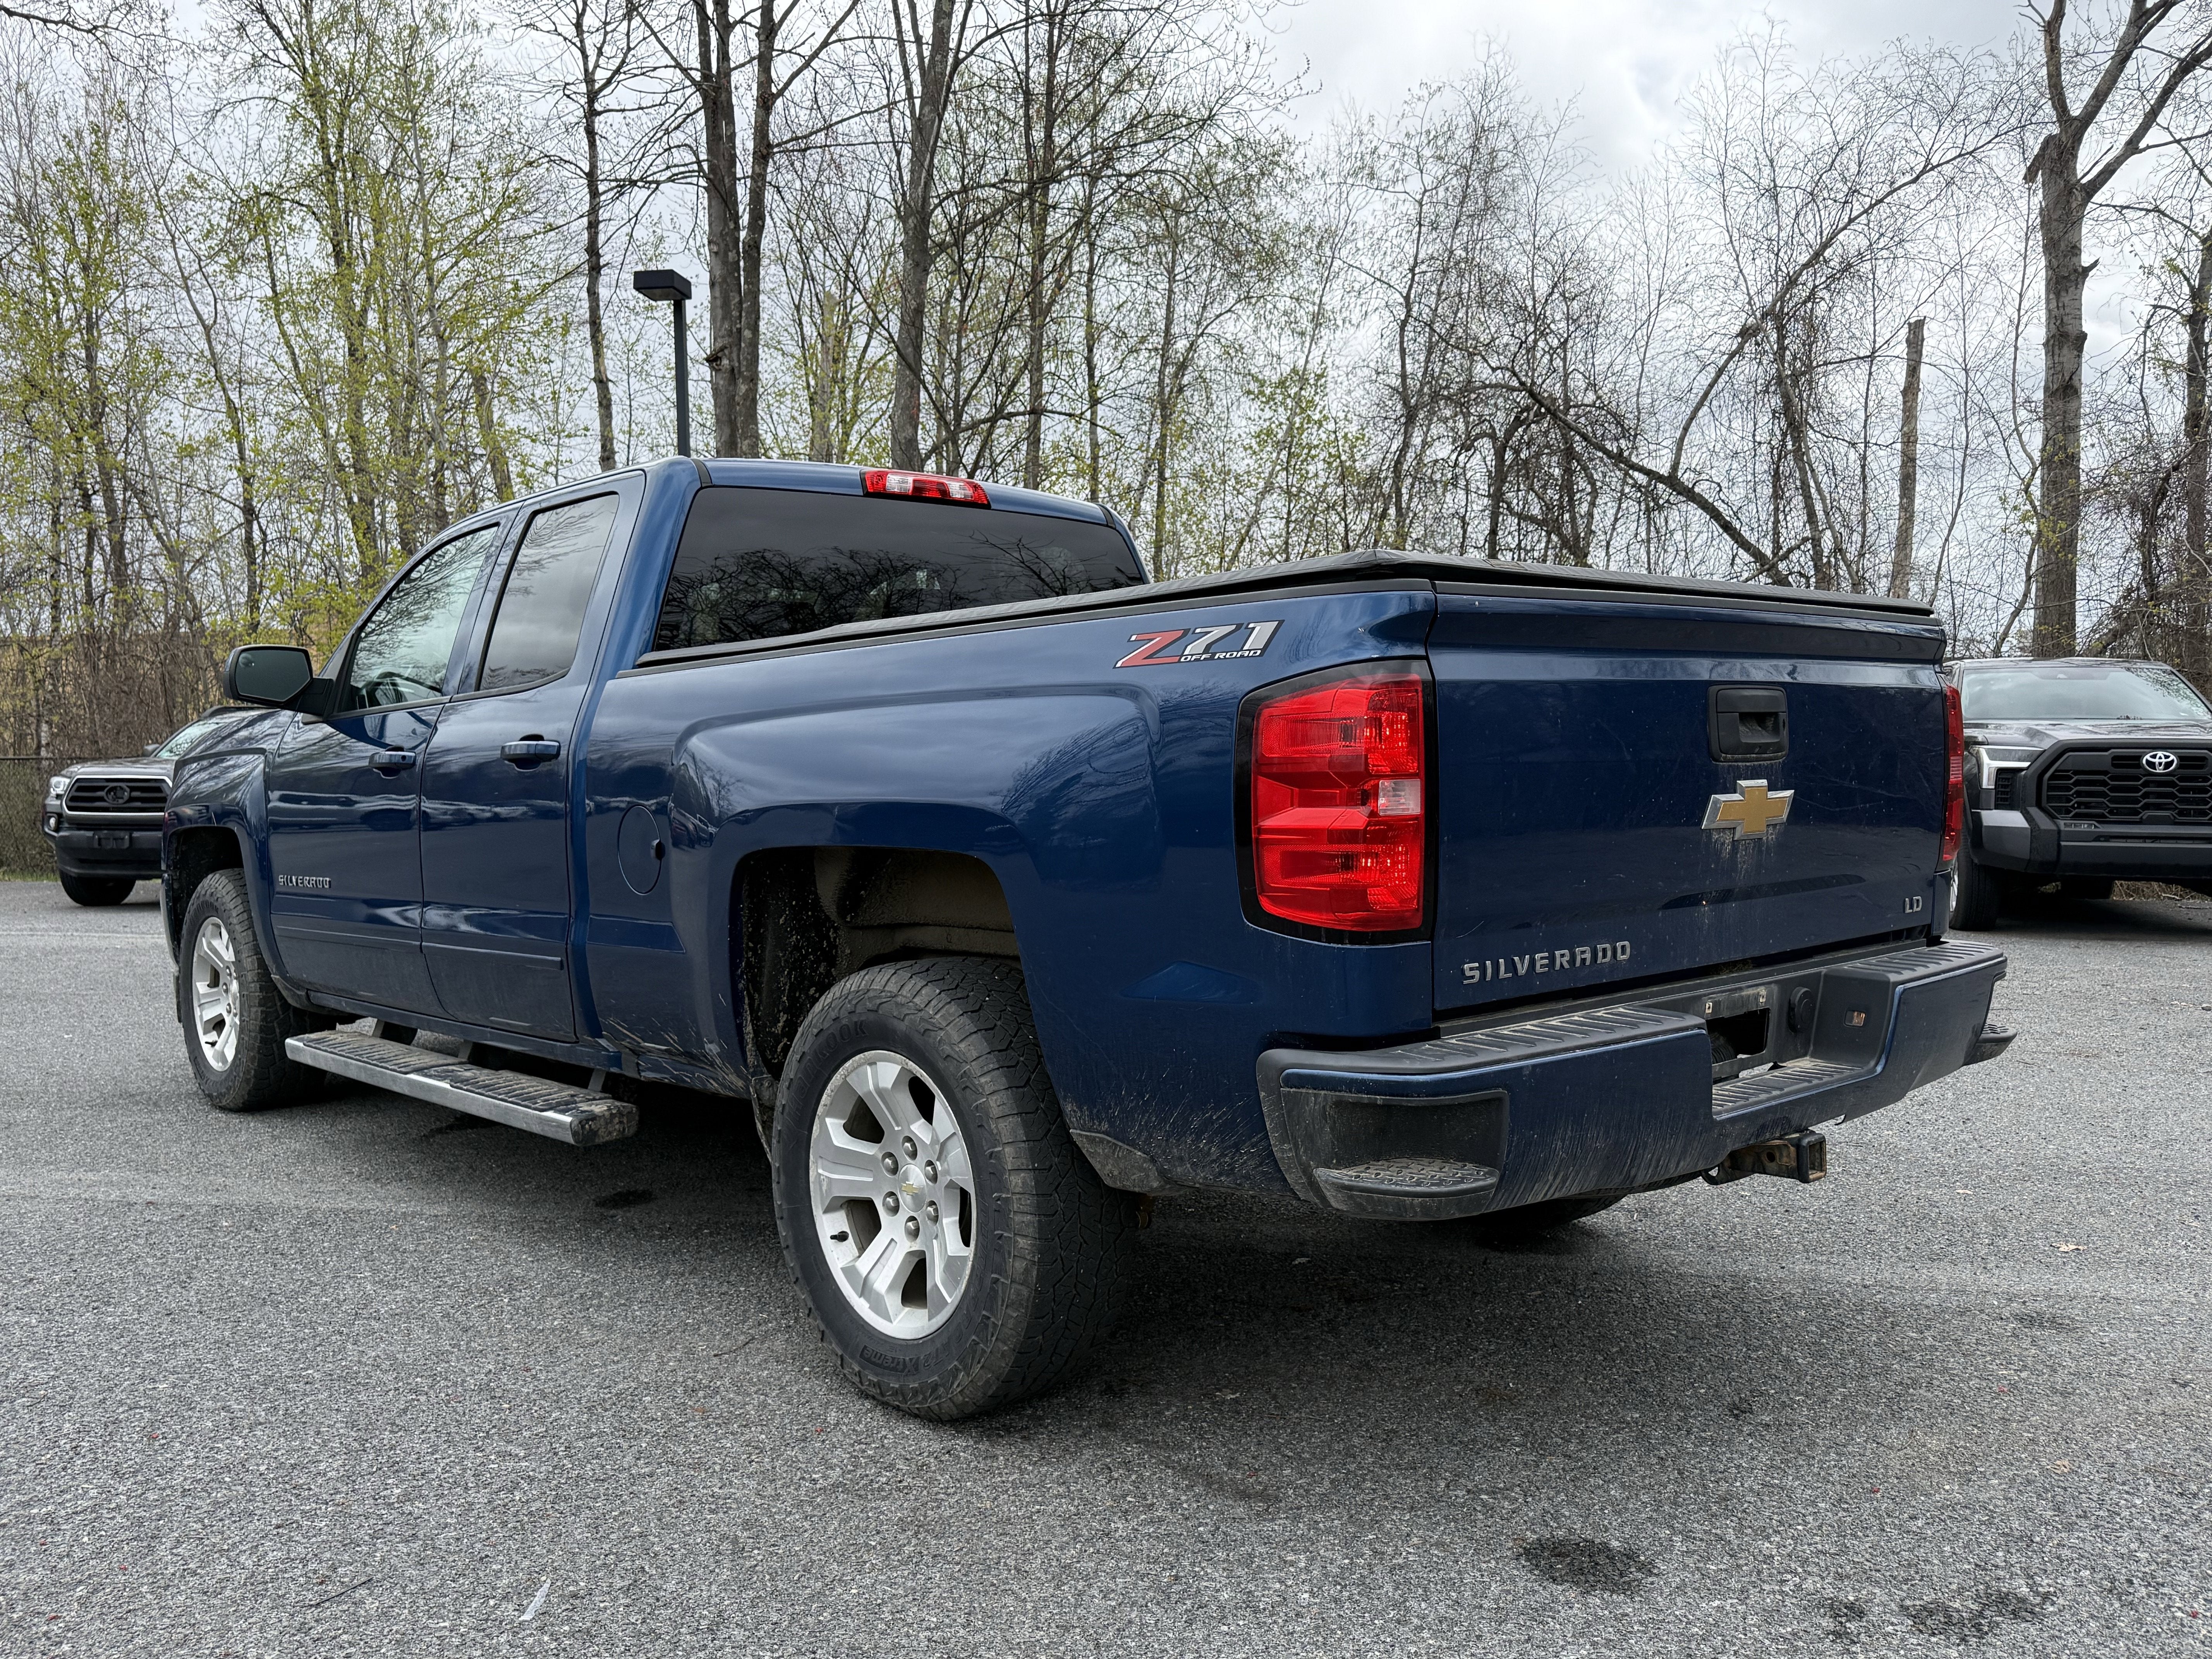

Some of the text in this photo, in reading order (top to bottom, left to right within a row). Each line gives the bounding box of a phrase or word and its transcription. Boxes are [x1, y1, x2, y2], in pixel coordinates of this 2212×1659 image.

[1113, 620, 1285, 669] Z71
[1180, 650, 1261, 662] OFF ROAD
[278, 874, 331, 888] SILVERADO
[1904, 896, 1922, 914] LD
[1463, 941, 1631, 984] SILVERADO
[864, 1348, 919, 1376] Xtreme
